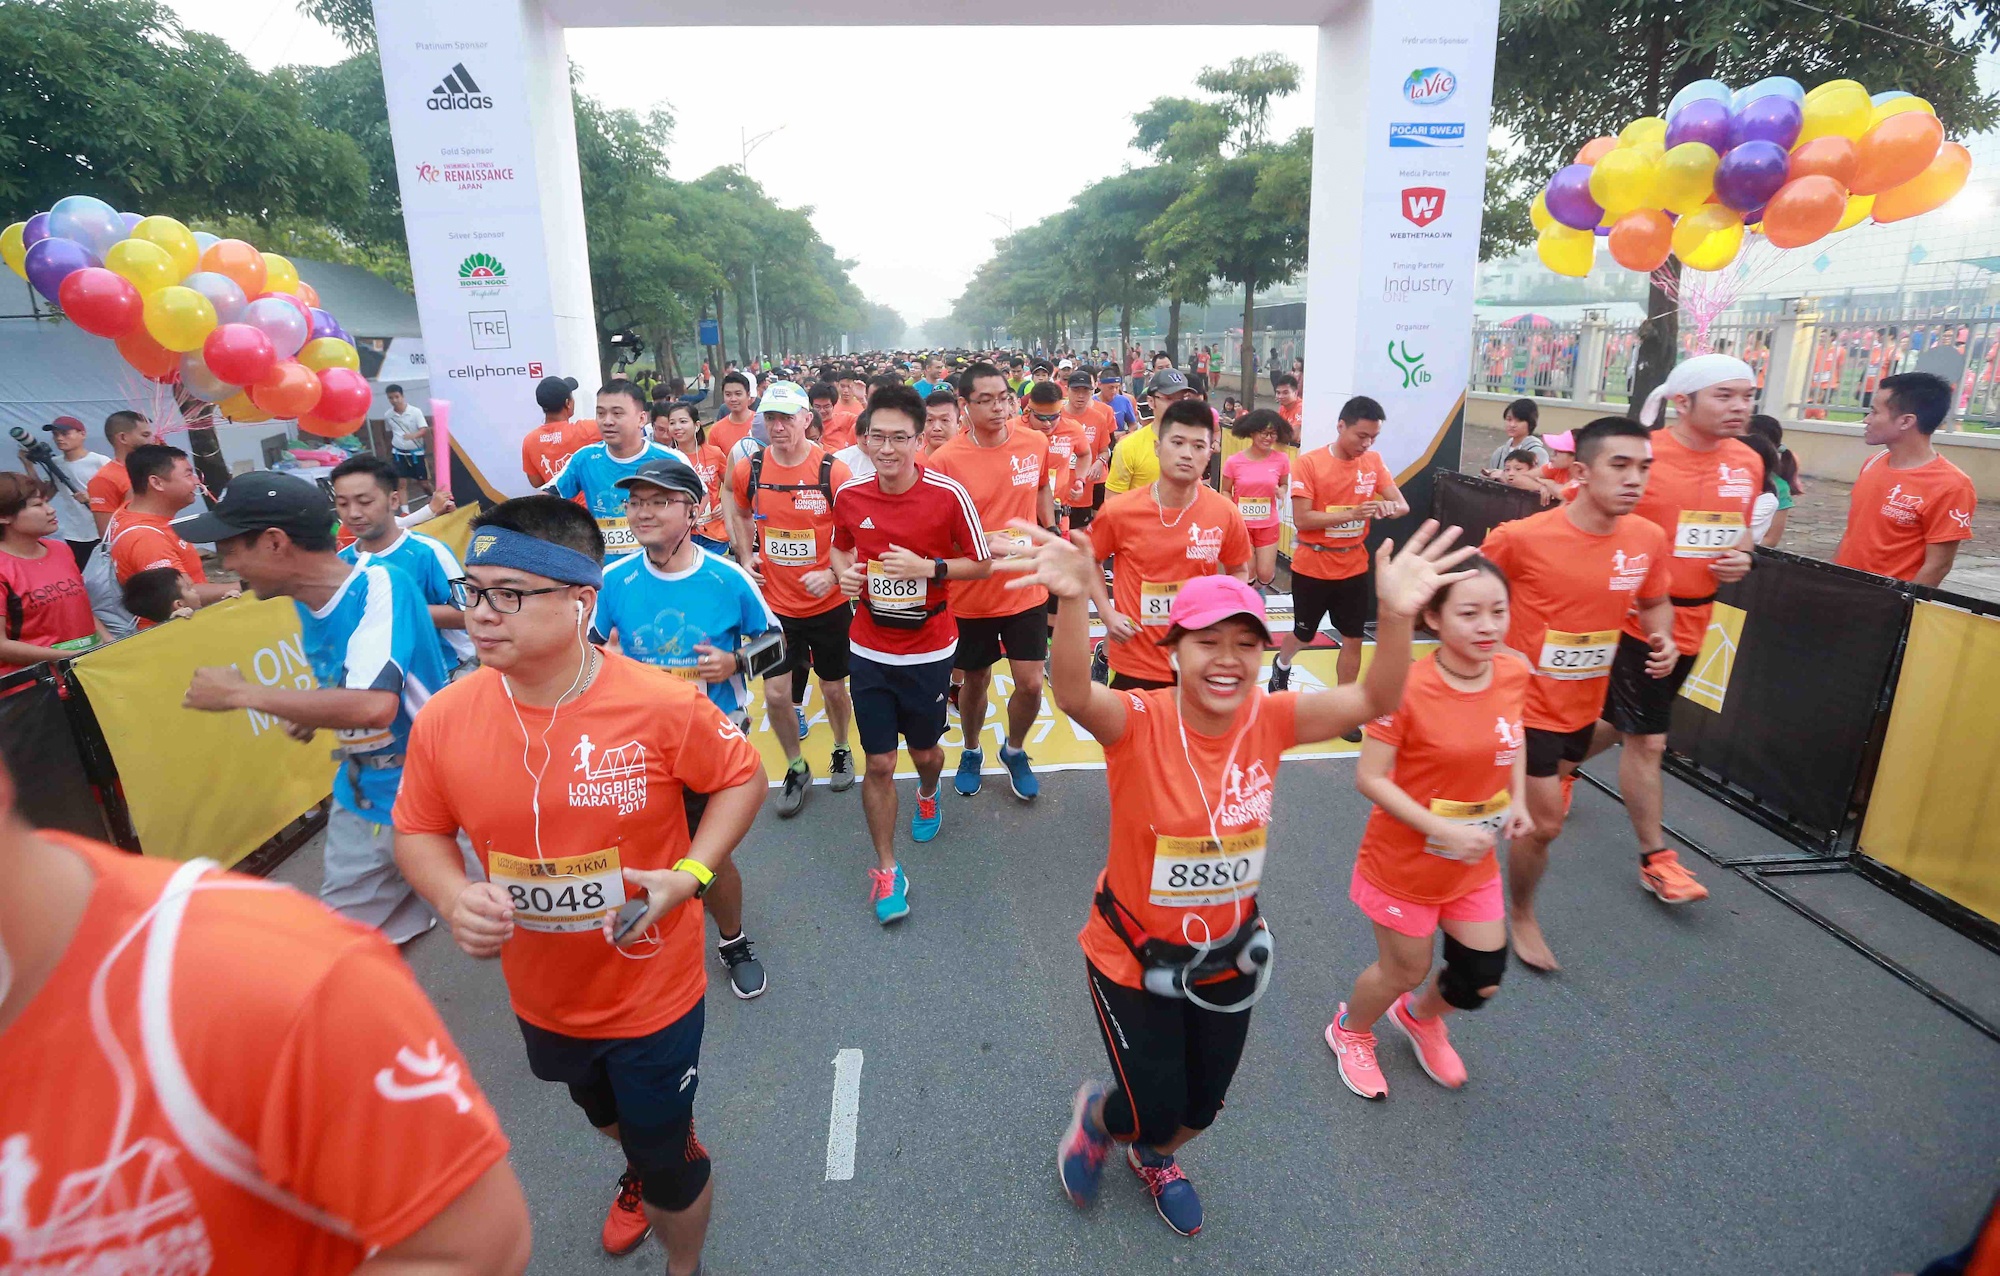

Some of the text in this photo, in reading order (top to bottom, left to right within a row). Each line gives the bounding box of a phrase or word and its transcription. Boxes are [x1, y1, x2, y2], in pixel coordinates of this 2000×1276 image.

[415, 41, 488, 50] Platinum Sponsor
[1439, 37, 1469, 45] Sponsor
[427, 93, 493, 110] adidas
[1391, 126, 1464, 135] POCARI SWEAT
[441, 147, 494, 156] Gold Sponsor
[444, 168, 514, 182] RENAISSANCE
[448, 231, 505, 240] Silver Sponsor
[1393, 261, 1445, 271] Timing Partner
[1384, 275, 1454, 296] Industry
[1382, 292, 1409, 303] ONE
[473, 321, 507, 335] TRE
[1395, 323, 1430, 332] Organizer
[1242, 504, 1267, 514] 8800
[1687, 528, 1738, 546] 8137
[770, 541, 808, 557] 8453
[25, 578, 78, 604] TOPICA
[872, 577, 918, 596] 8868
[1551, 649, 1606, 667] 8275
[568, 776, 648, 797] LONGBIEN
[568, 788, 648, 808] MARATHON
[618, 798, 648, 816] 2017
[565, 858, 608, 875] 21KM
[1168, 858, 1250, 888] 8880
[507, 882, 606, 913] 8048
